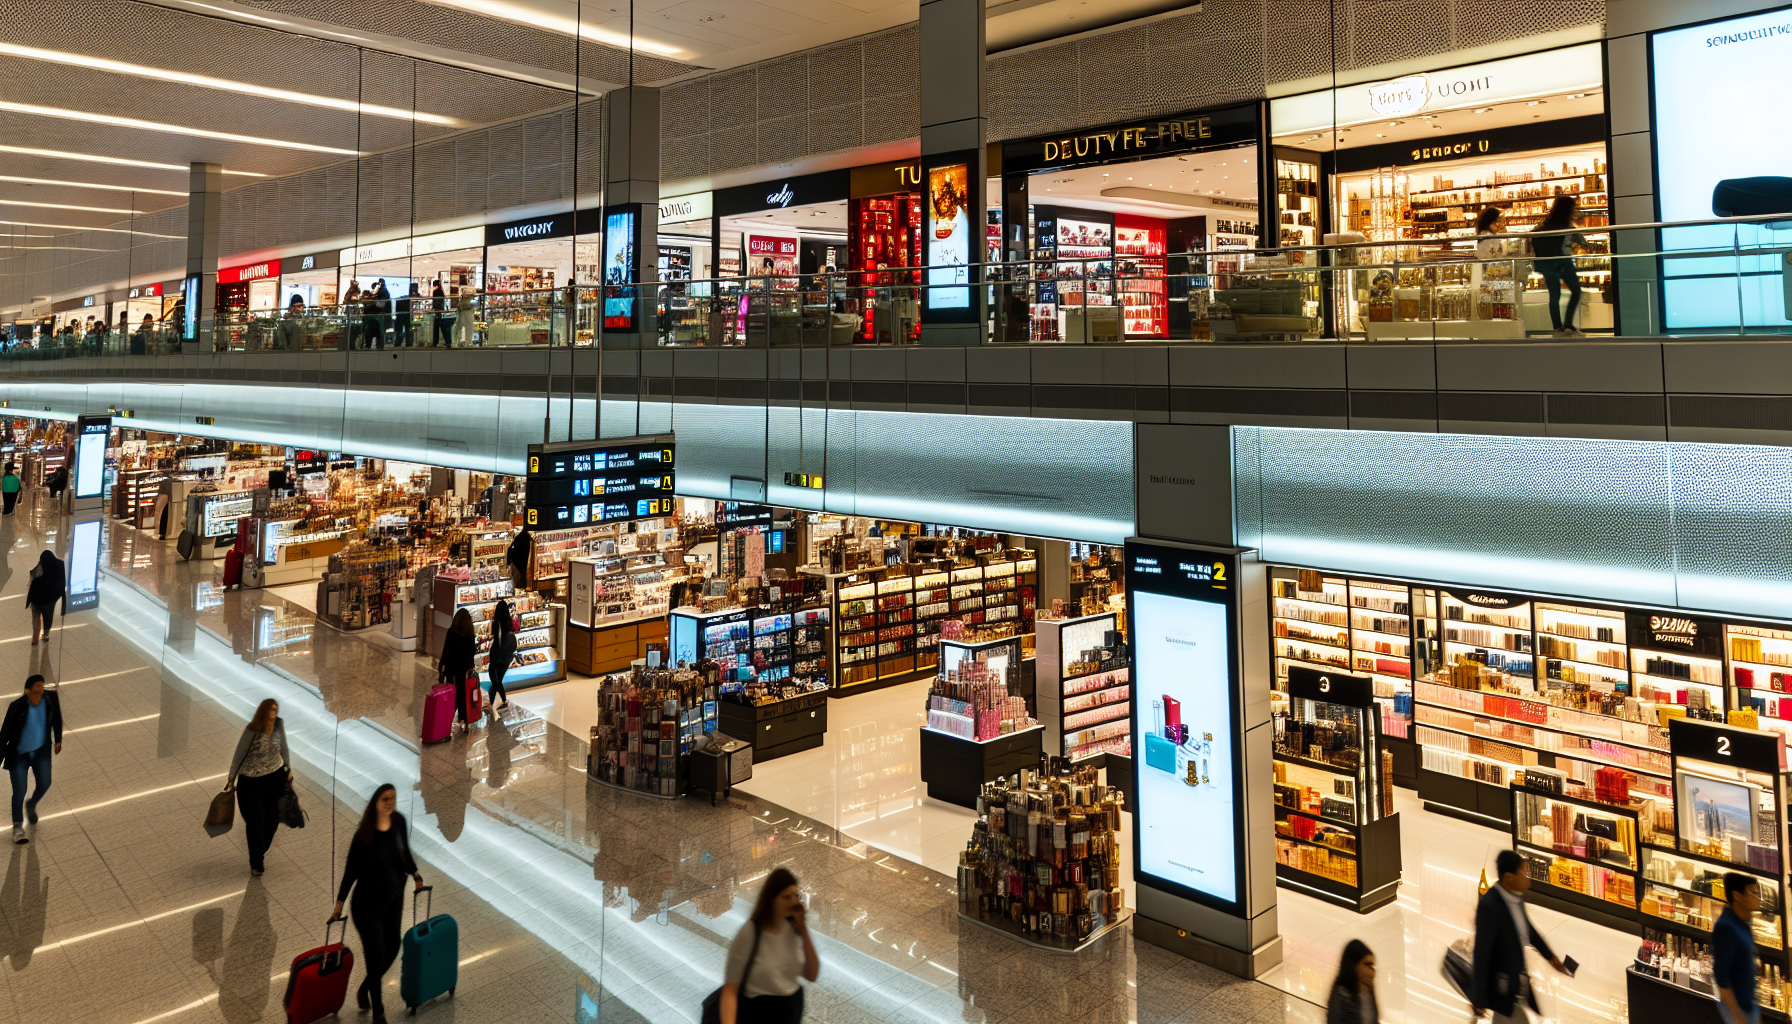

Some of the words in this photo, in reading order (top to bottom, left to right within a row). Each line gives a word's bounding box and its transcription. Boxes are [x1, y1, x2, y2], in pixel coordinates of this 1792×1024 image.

[1213, 561, 1227, 580] 2
[1318, 676, 1330, 693] 3
[1716, 736, 1731, 756] 2
